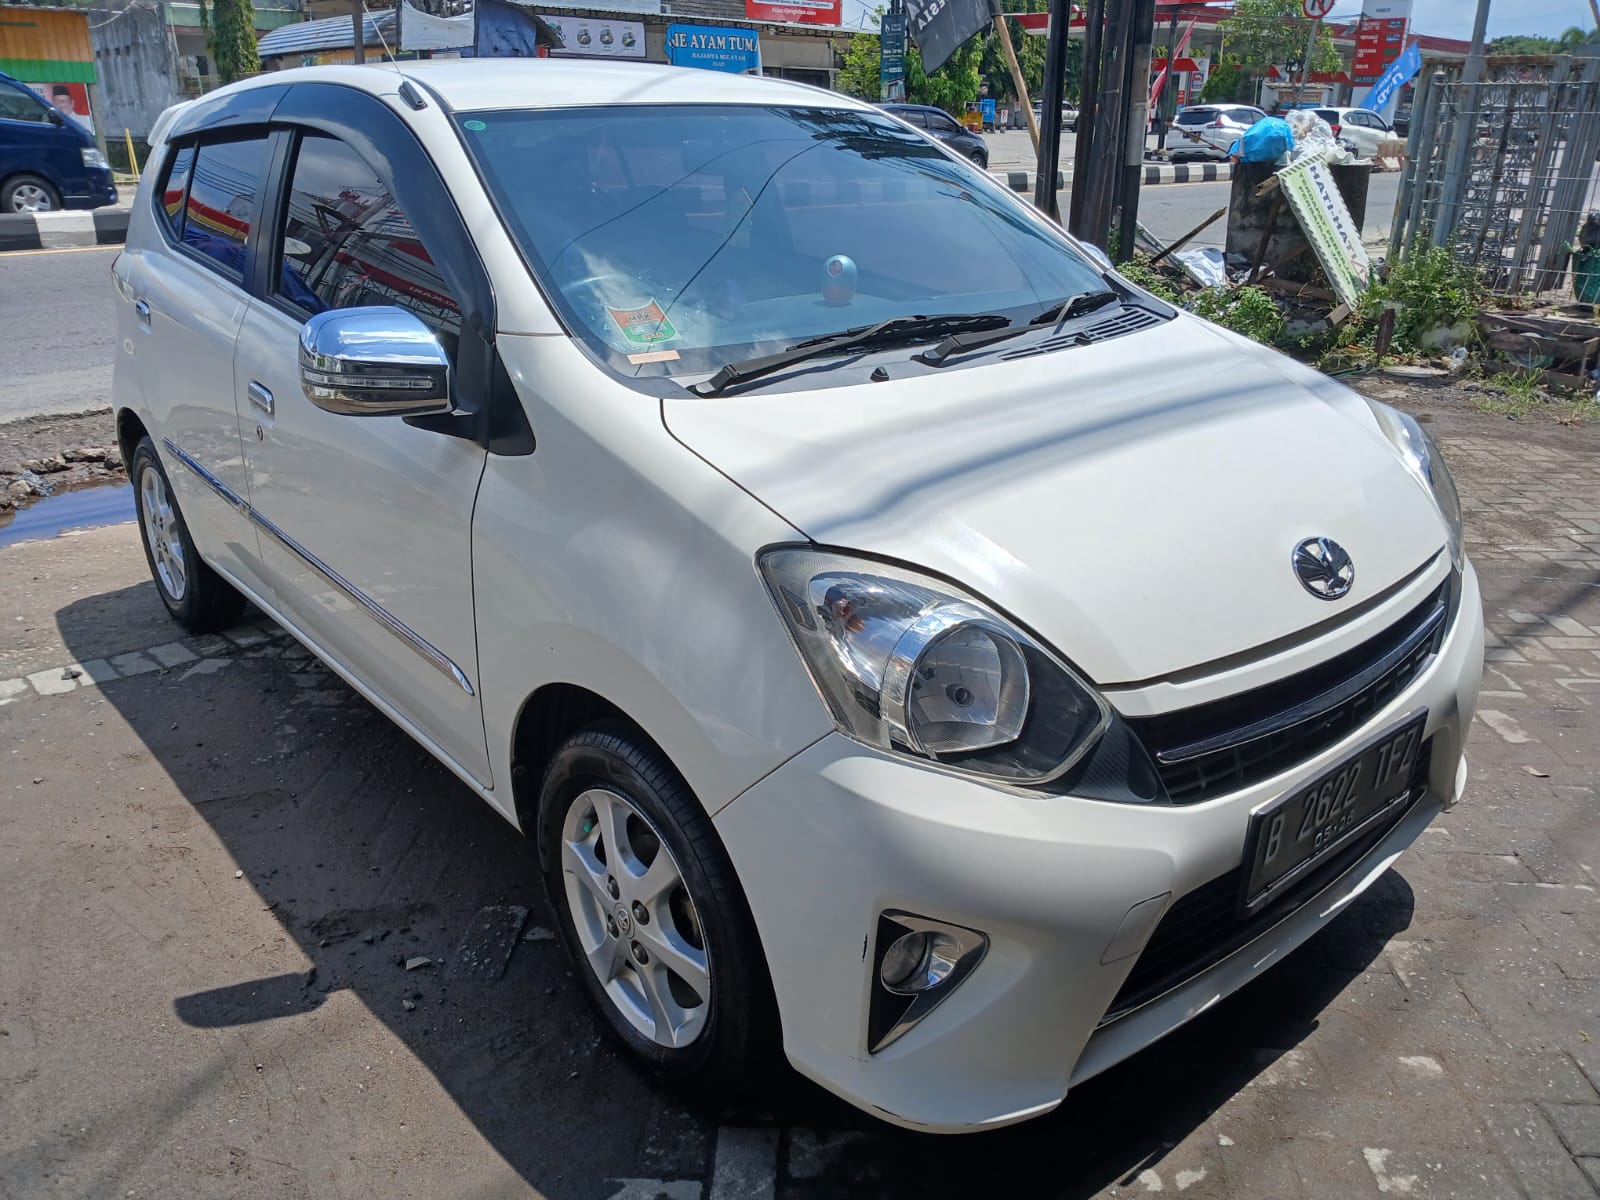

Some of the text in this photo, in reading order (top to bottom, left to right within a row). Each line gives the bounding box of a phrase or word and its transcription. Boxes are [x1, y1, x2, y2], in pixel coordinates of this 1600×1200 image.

[690, 33, 726, 50] AYAM
[1310, 166, 1358, 259] HATI-HATI
[1265, 727, 1417, 866] B 2622 TFZ
